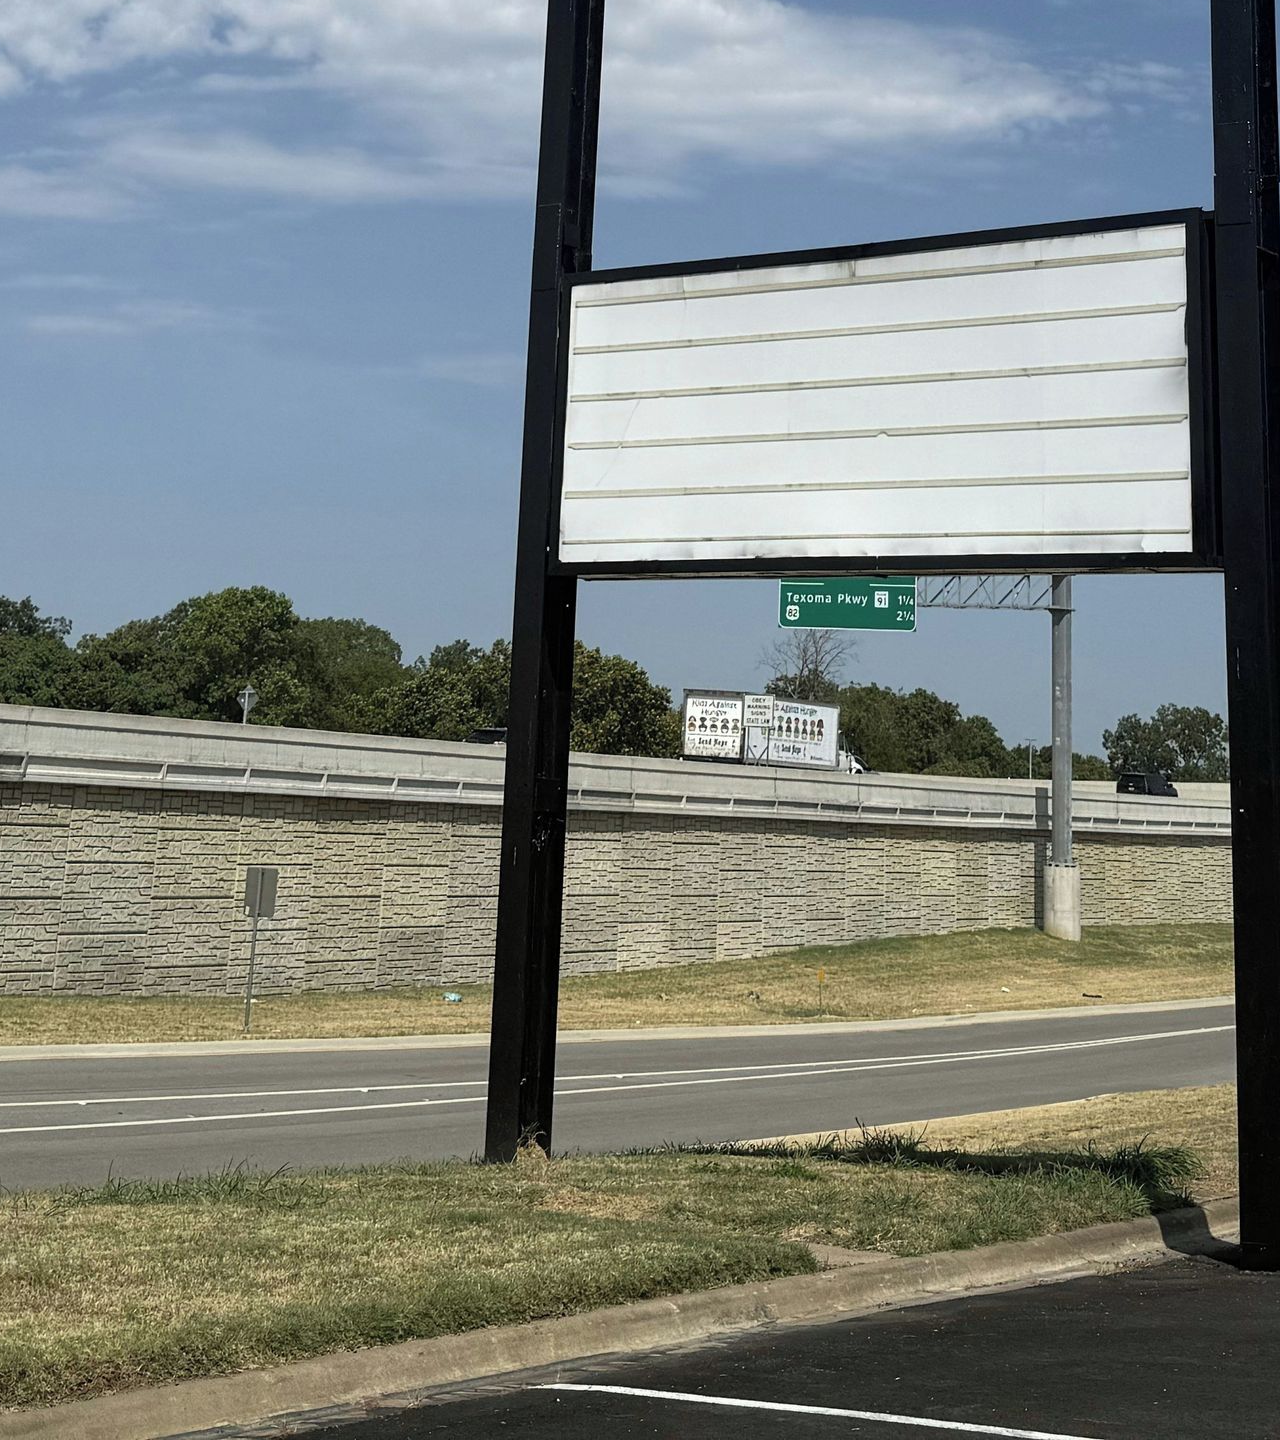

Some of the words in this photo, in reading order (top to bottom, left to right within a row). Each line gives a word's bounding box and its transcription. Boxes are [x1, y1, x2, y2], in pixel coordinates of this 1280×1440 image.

[786, 592, 832, 604] Texoma
[837, 593, 868, 607] Pkwy
[877, 596, 887, 606] 91
[787, 608, 798, 618] 82
